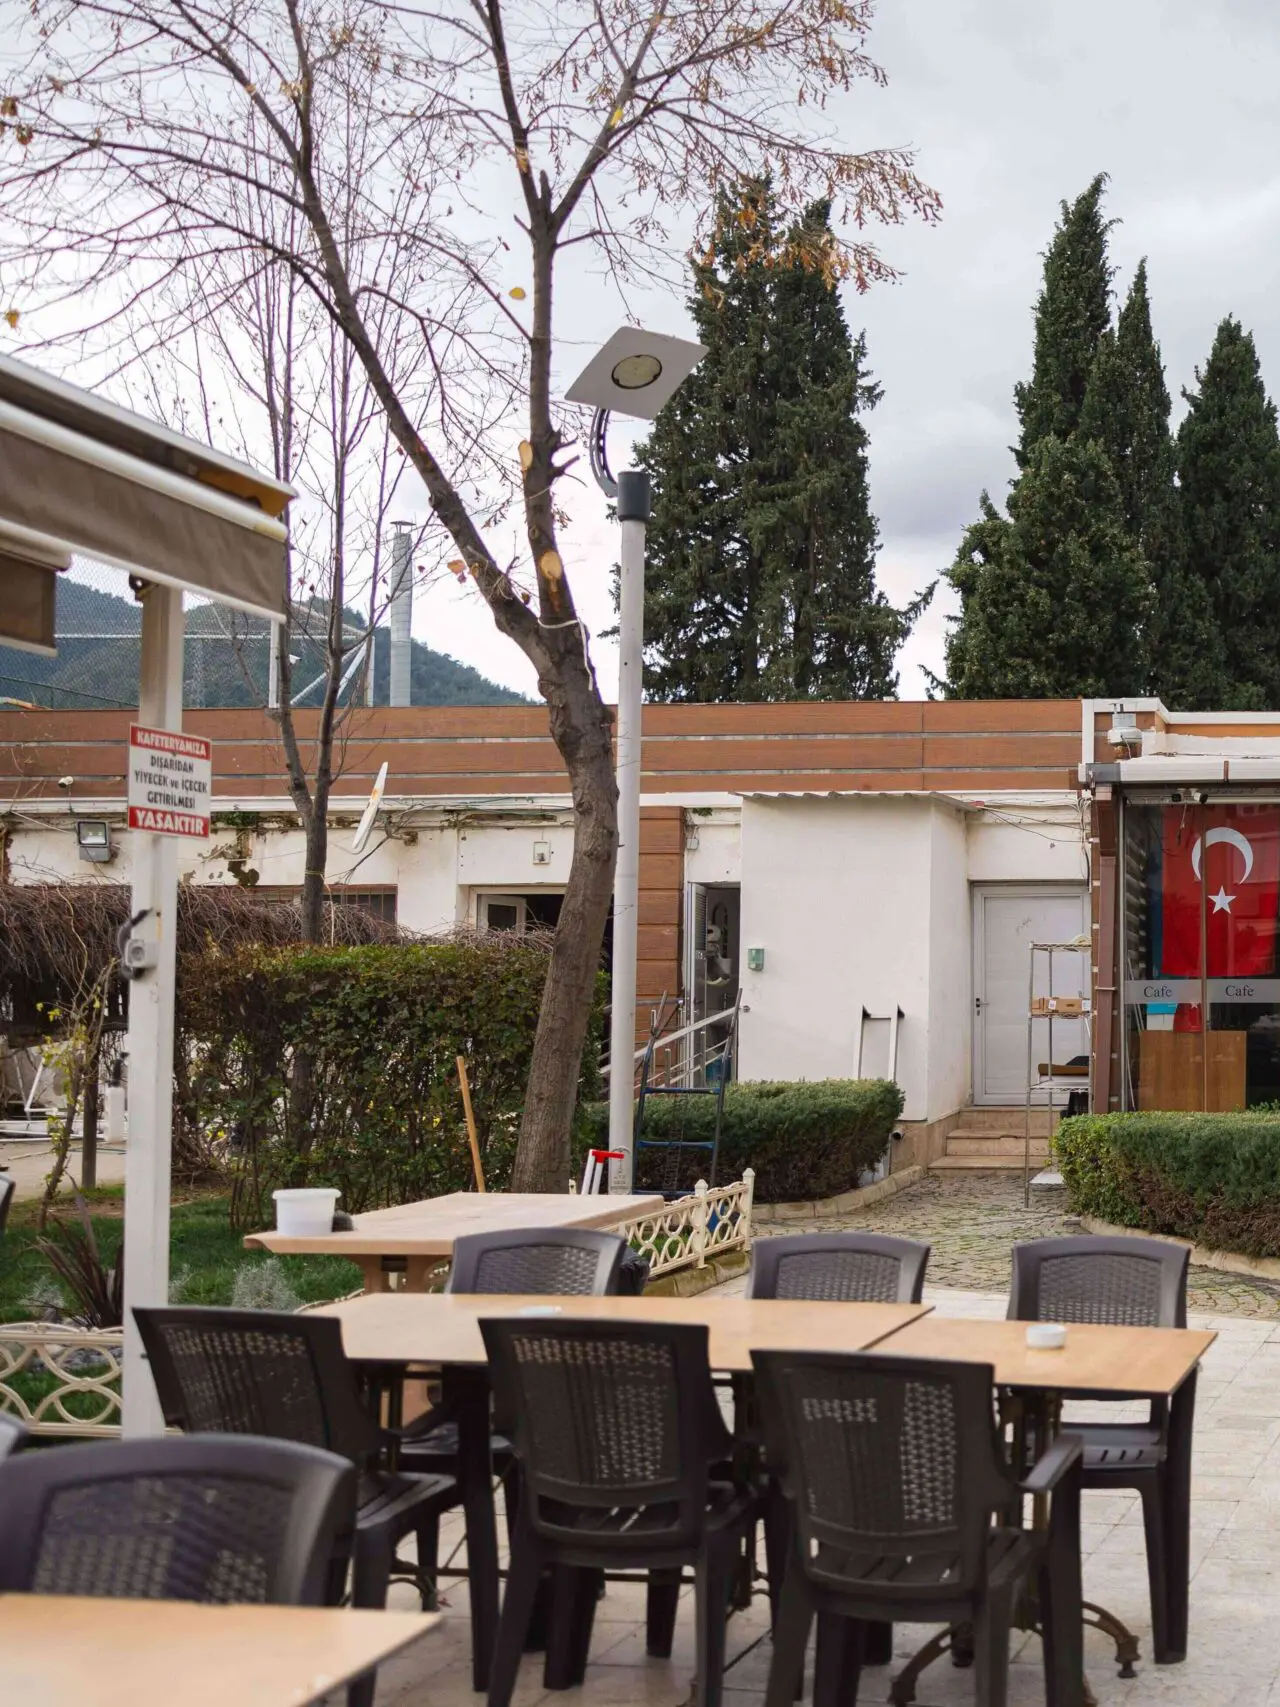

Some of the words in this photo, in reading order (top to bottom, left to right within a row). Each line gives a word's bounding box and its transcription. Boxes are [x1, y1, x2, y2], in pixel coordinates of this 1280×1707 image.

[136, 730, 207, 757] KAFETERYAMIZA
[150, 755, 194, 773] DIŞARIDAN
[134, 769, 168, 787] YİYECEK
[170, 780, 179, 789] ve
[181, 779, 208, 794] İÇECEK
[147, 789, 196, 809] GETİRİLMESİ
[135, 809, 205, 835] YASAKTIR
[1143, 985, 1173, 998] Cafe
[1225, 984, 1255, 997] Cafe
